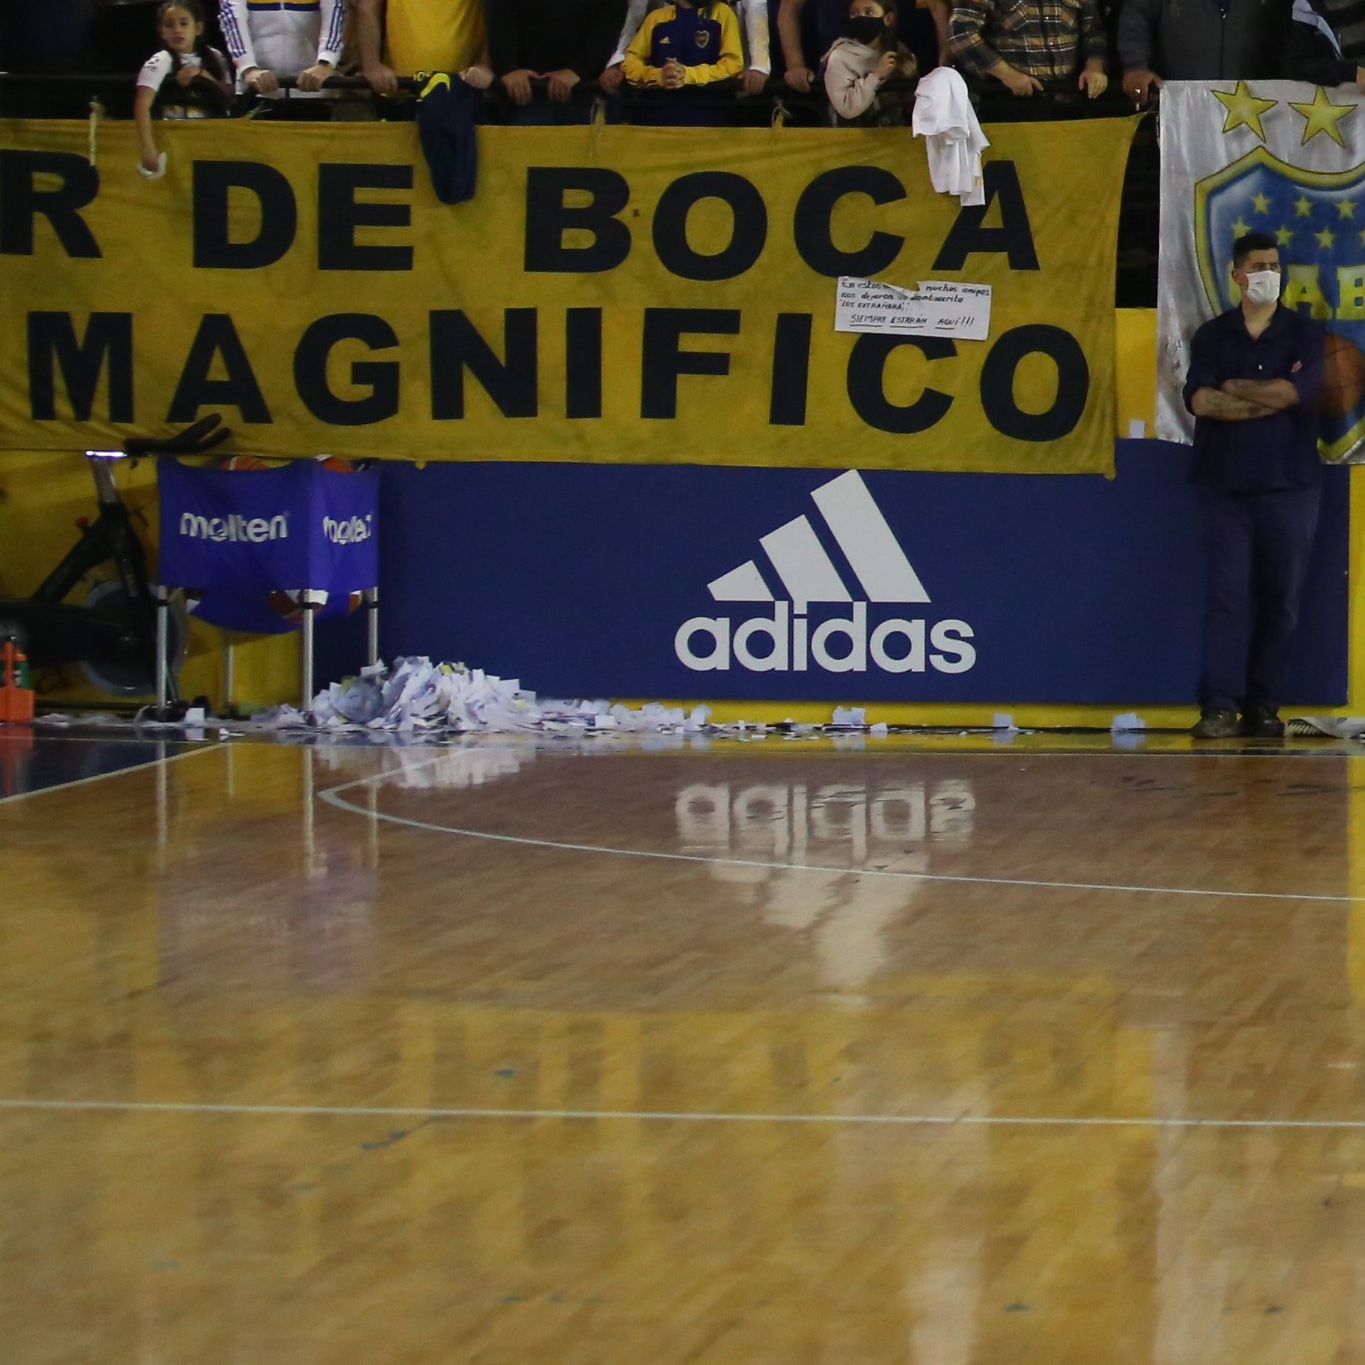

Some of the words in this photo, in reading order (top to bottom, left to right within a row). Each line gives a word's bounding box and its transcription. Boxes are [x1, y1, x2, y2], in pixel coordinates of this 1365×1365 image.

[193, 160, 414, 272] DE
[524, 160, 1040, 281] BOCA
[27, 306, 1090, 442] MAGNIFICO
[180, 511, 290, 543] molten
[674, 600, 977, 674] adidas
